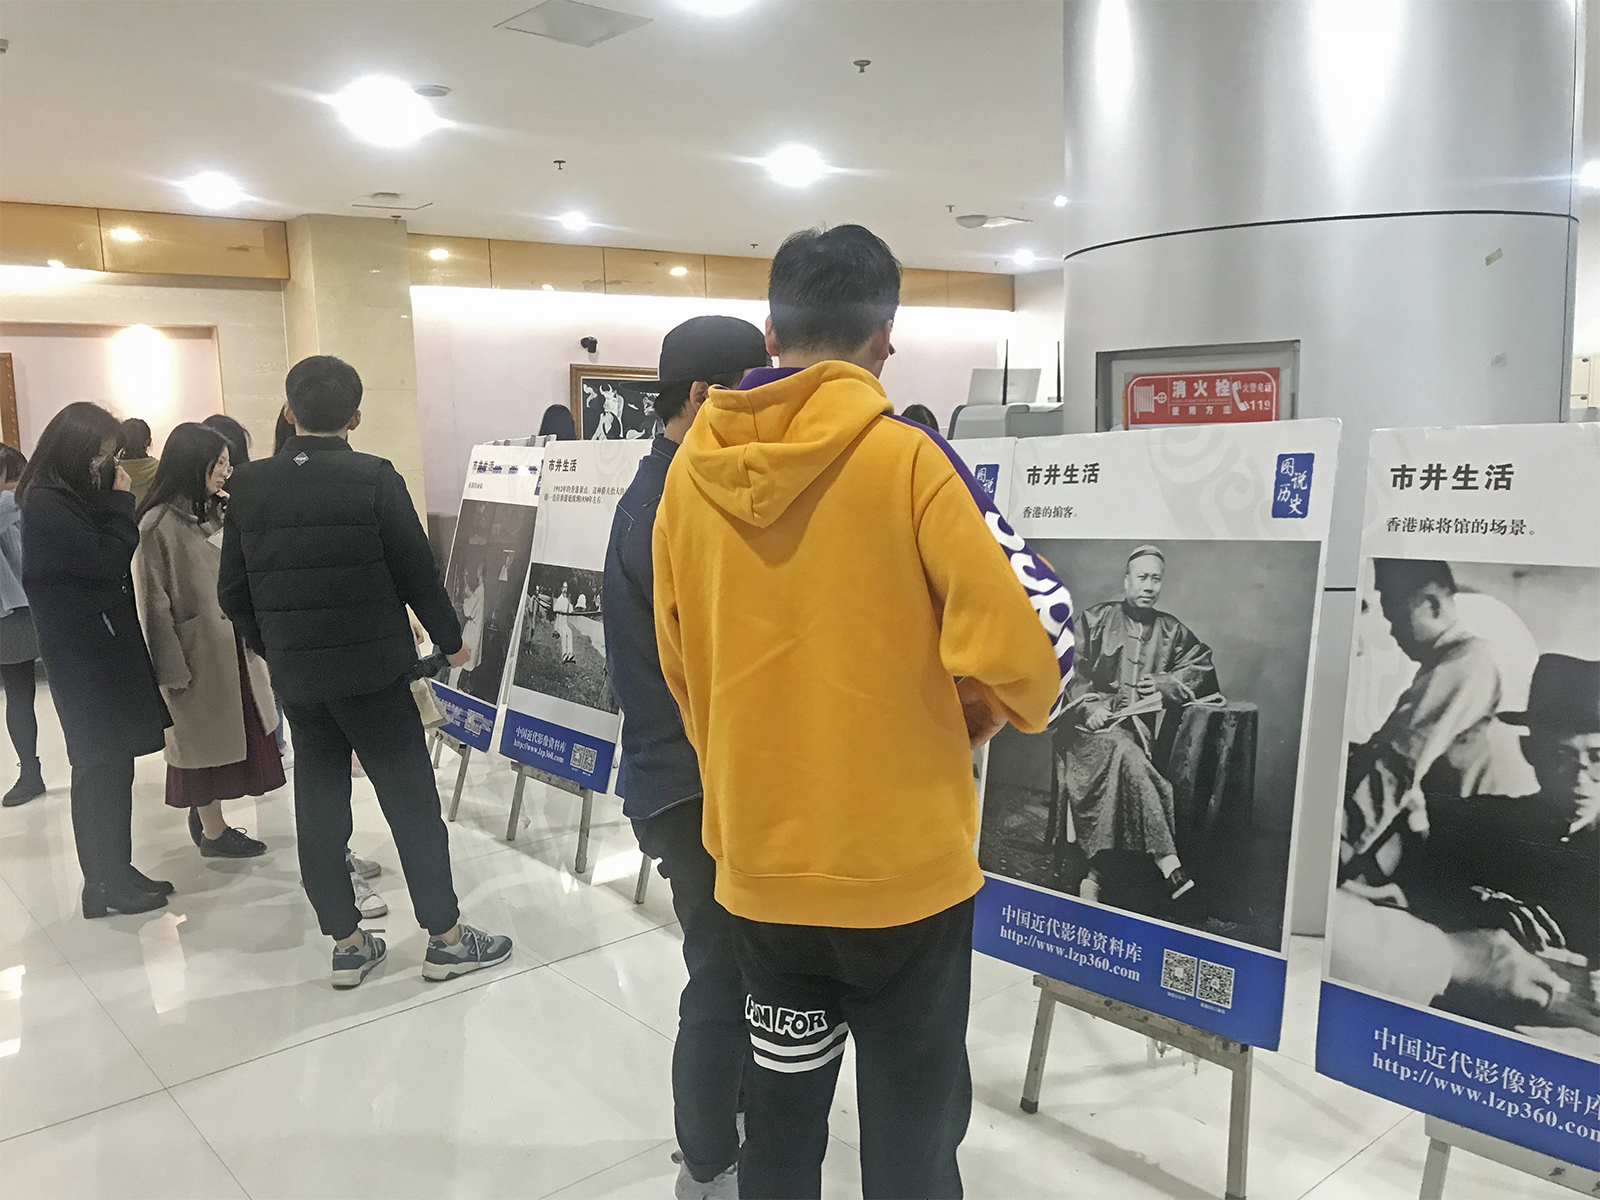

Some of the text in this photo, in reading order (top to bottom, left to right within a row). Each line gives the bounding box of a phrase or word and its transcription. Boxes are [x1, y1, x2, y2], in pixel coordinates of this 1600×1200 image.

[1172, 379, 1231, 398] 消火栓
[1250, 400, 1271, 411] 119
[548, 459, 577, 472] 市井生活
[1026, 463, 1100, 485] 市井生活
[1390, 463, 1515, 490] 市井生活
[1386, 516, 1535, 536] 香港麻将馆的场景。
[513, 739, 564, 764] http://www.lzp360.com
[515, 725, 567, 753] 中国近代影像资料库
[1002, 904, 1143, 963] 中国近代影像资料库
[1000, 925, 1141, 982] http://www.lzp360.com
[774, 1007, 828, 1039] FOR
[1374, 1027, 1600, 1122] 中国近代影像资料库
